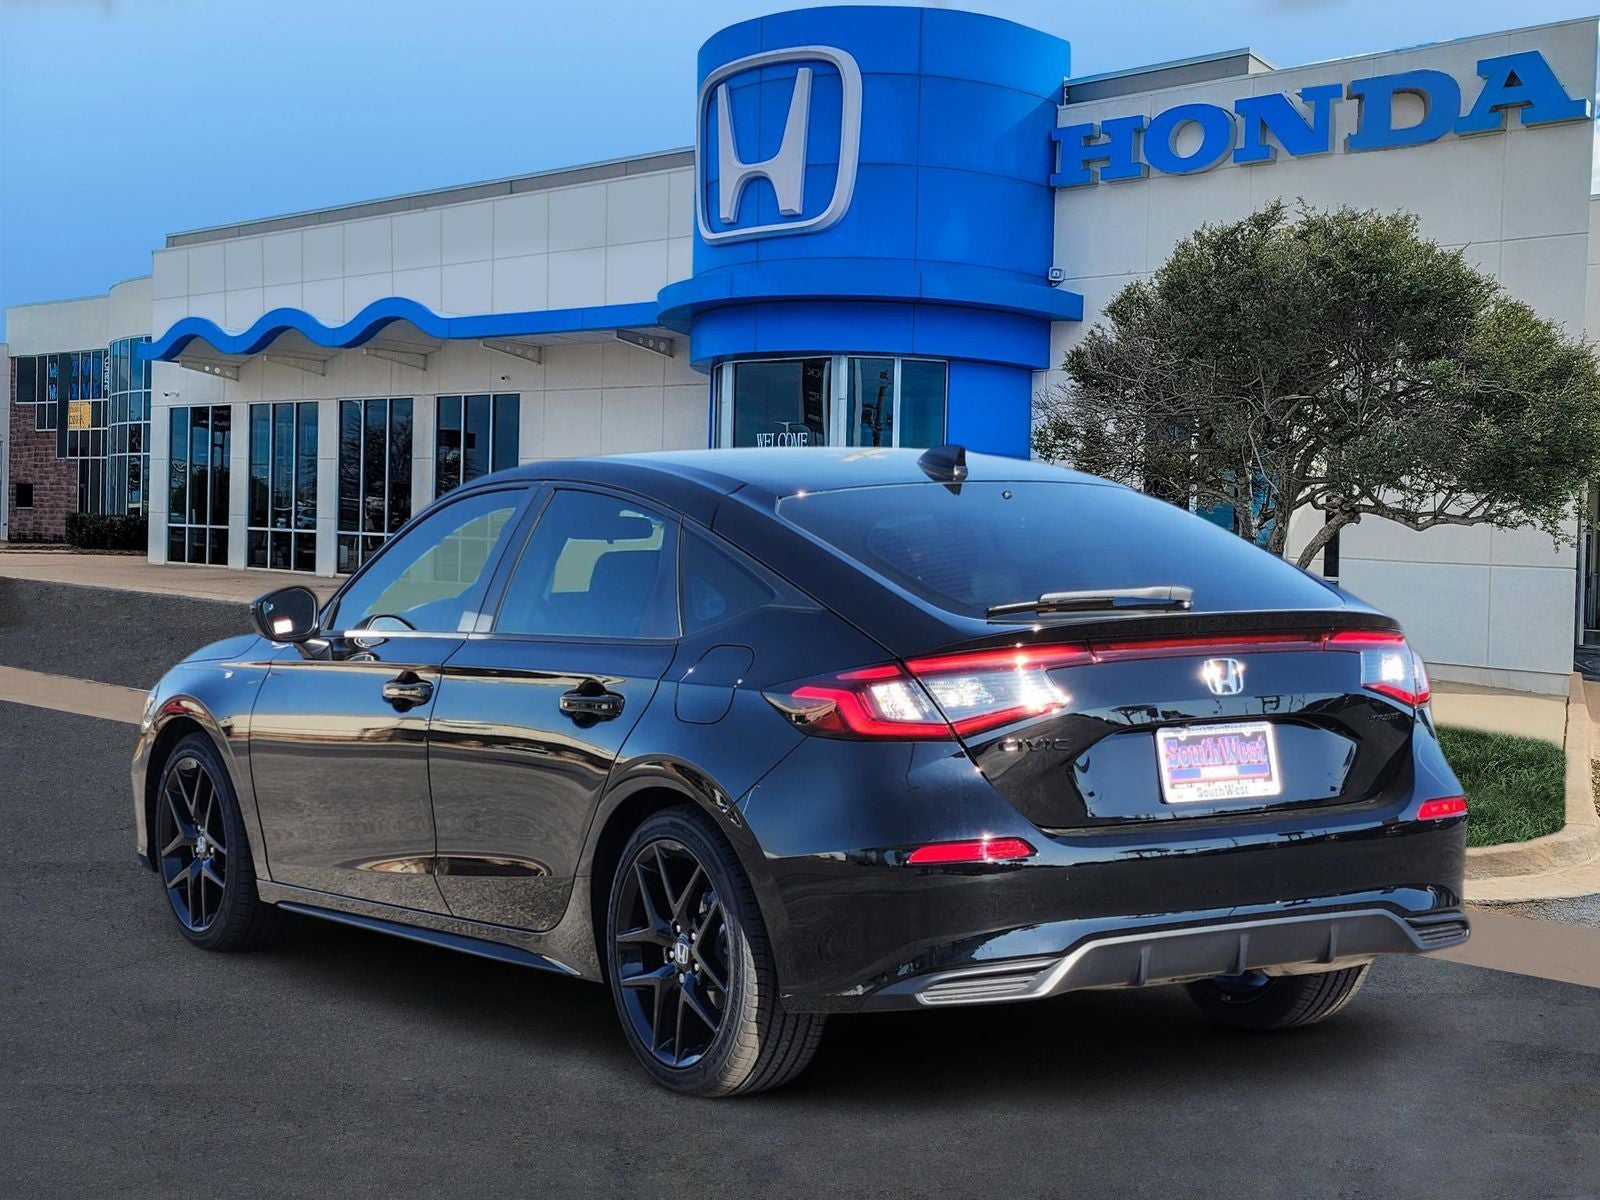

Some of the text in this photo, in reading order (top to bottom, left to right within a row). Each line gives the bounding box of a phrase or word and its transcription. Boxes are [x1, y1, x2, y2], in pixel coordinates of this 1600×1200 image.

[1050, 50, 1591, 187] HONDA
[998, 737, 1070, 752] CIVIC
[1165, 734, 1268, 768] SouthWest
[1196, 784, 1250, 798] SouthWest
